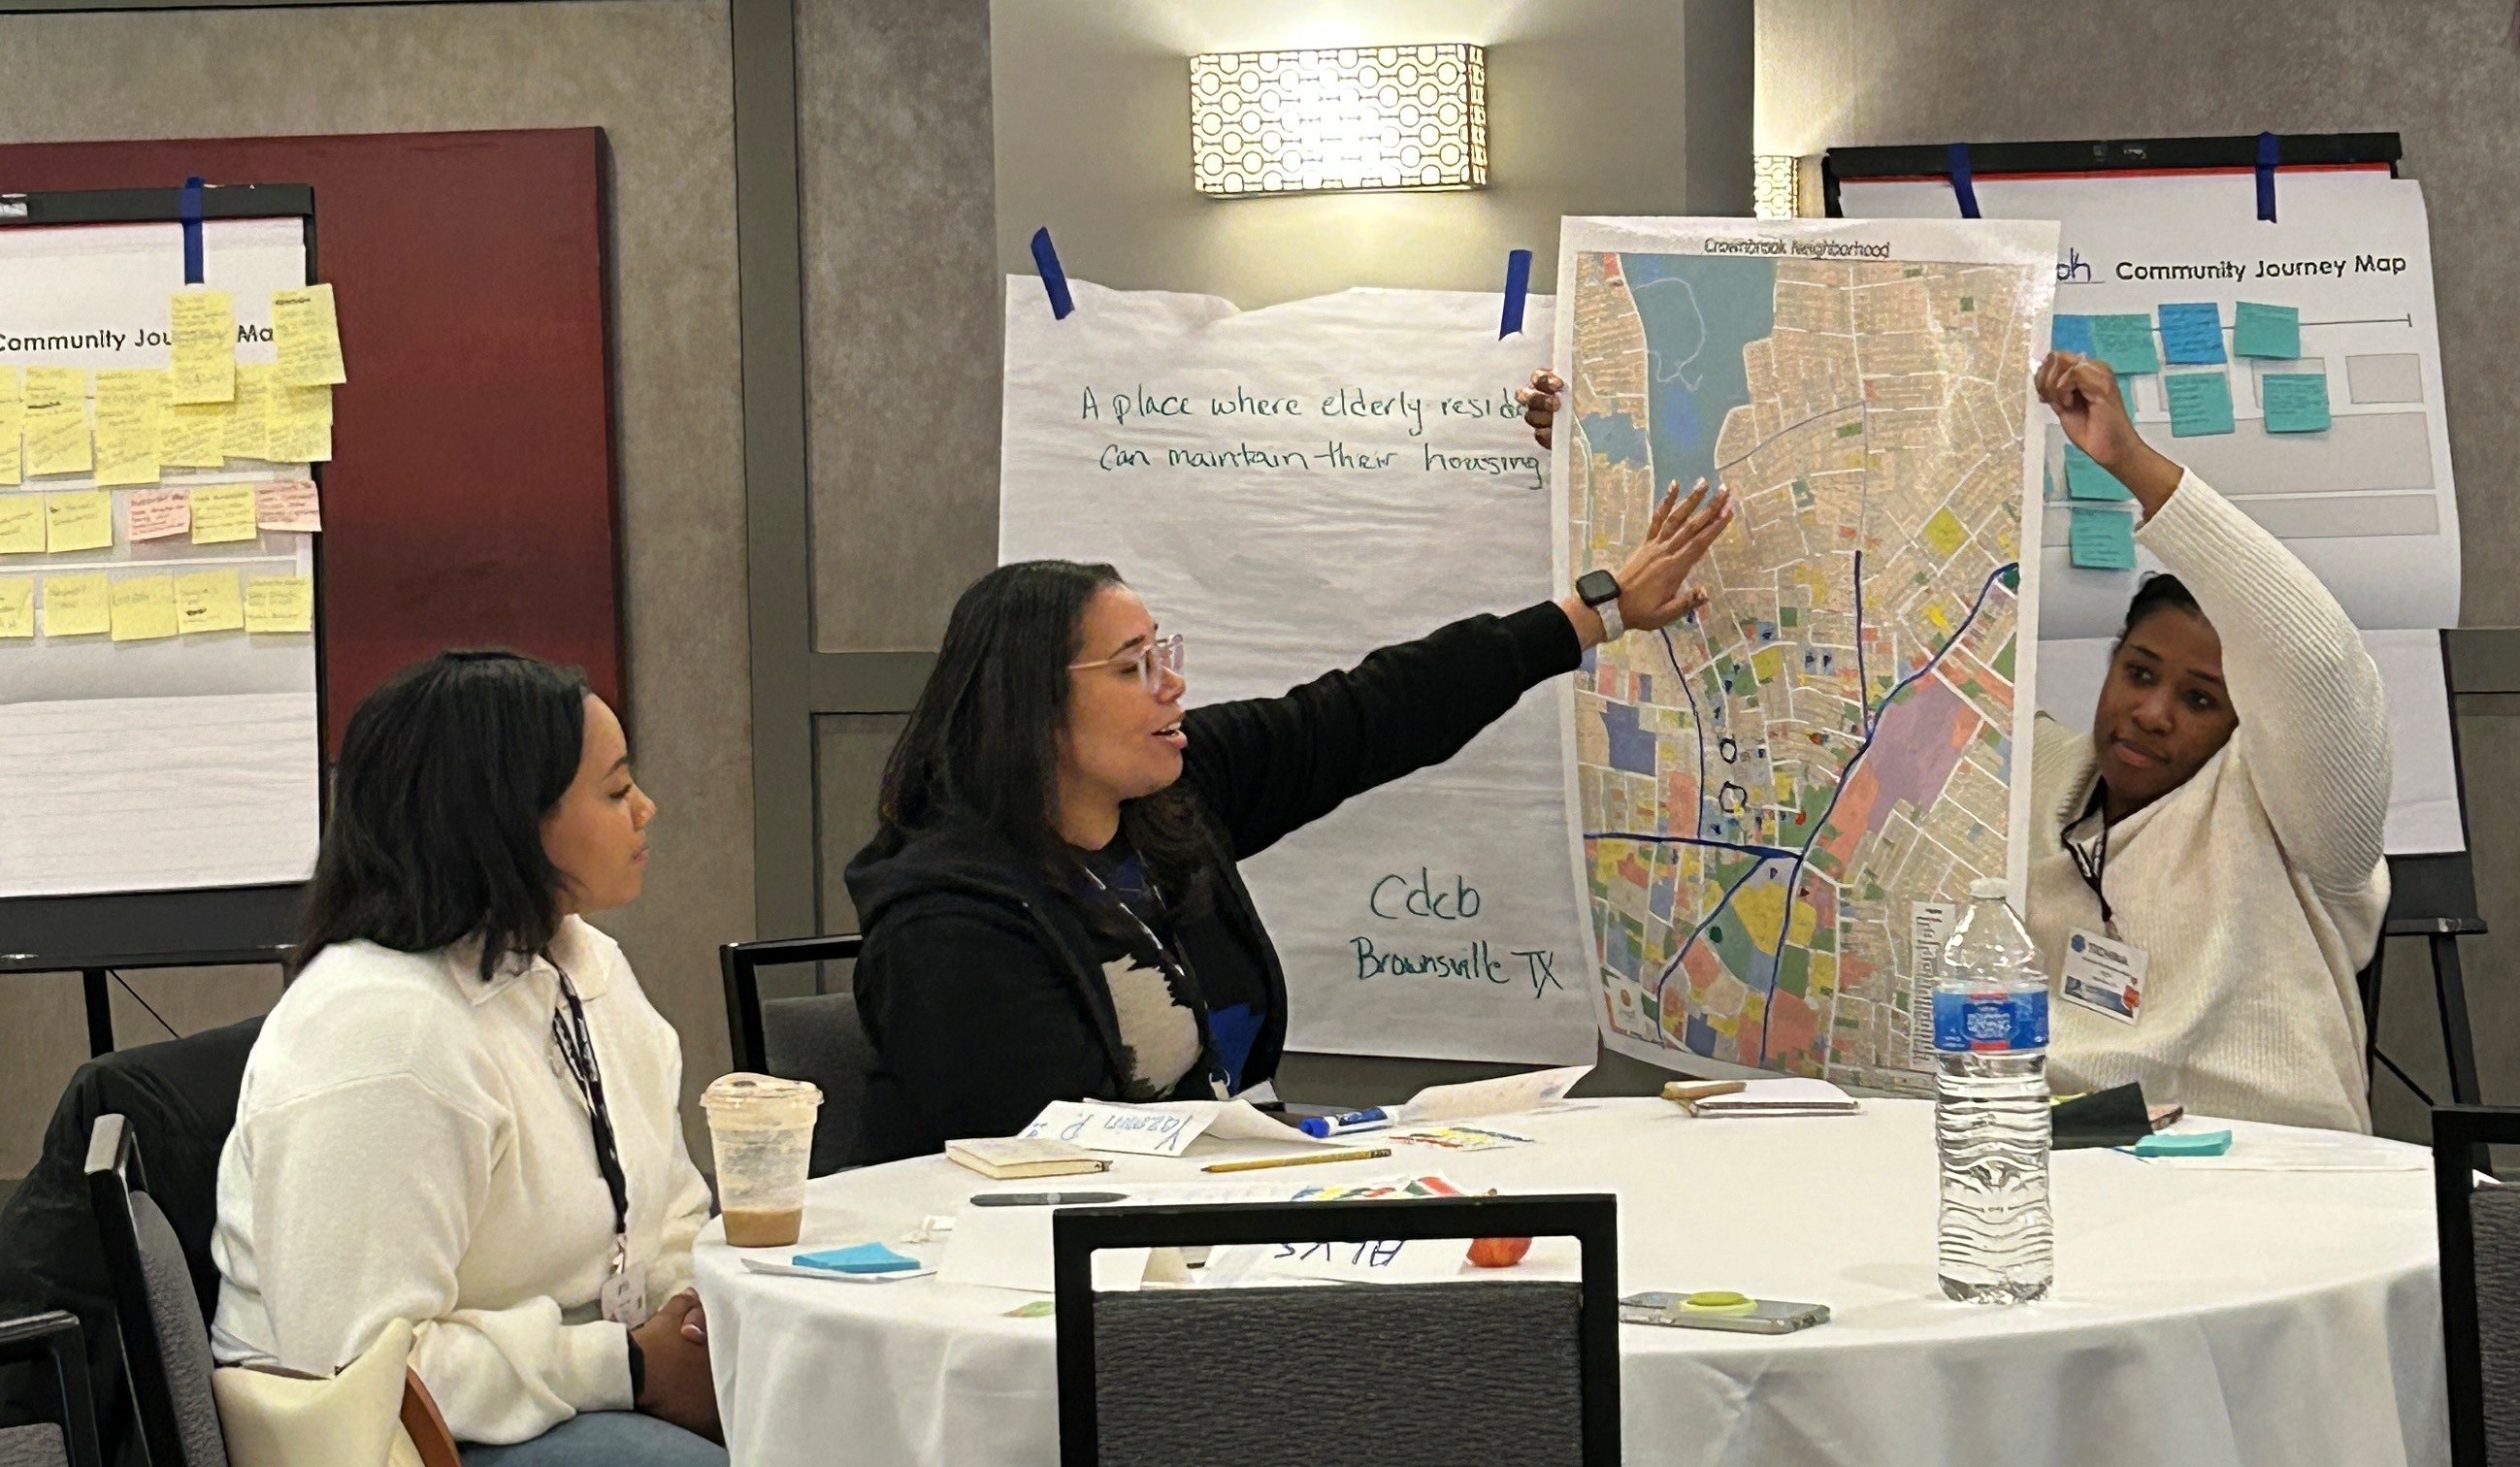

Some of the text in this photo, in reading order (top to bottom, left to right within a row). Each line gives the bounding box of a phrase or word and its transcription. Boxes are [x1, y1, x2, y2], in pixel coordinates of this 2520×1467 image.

[2115, 254, 2407, 282] Community Journey Map
[236, 323, 274, 342] Ma
[1082, 385, 1098, 420] A
[1112, 383, 1194, 425] place
[1211, 385, 1302, 416] where
[1322, 388, 1424, 437] elderly
[1167, 441, 1310, 471] maintain
[1424, 441, 1544, 490] housing
[1349, 935, 1564, 999] Brownsville TX
